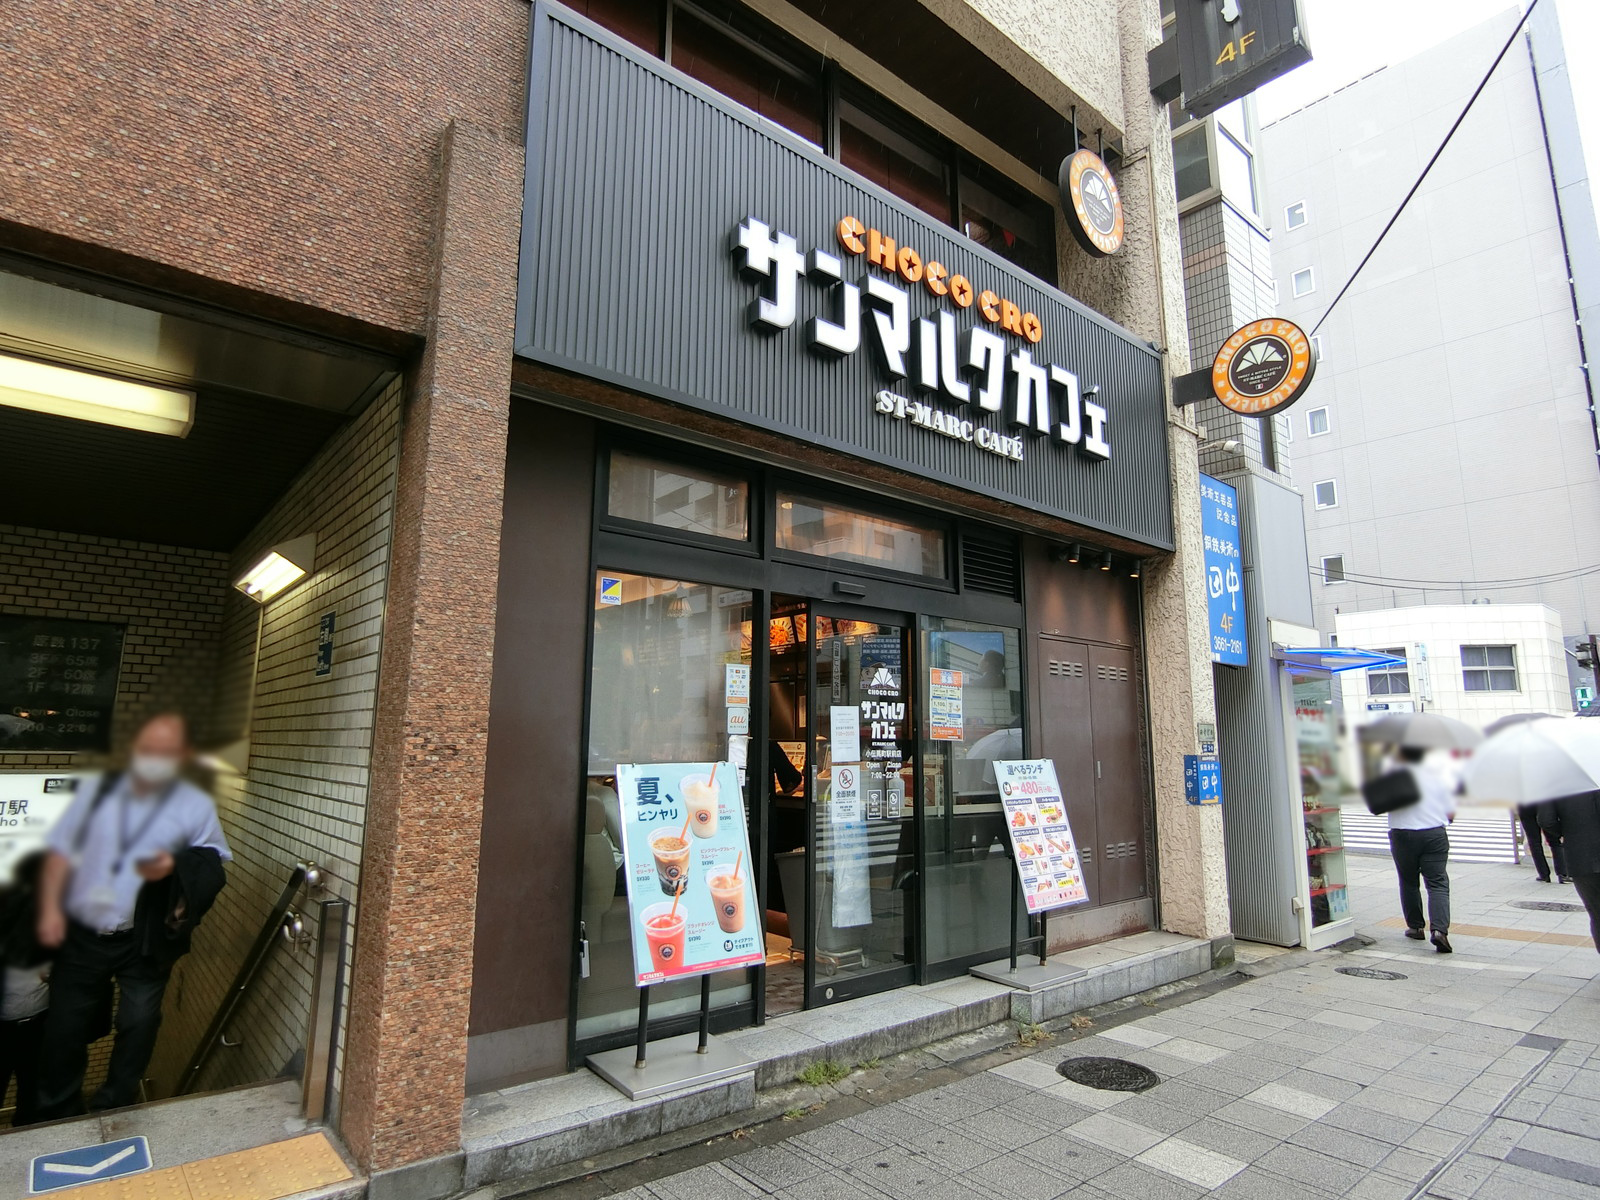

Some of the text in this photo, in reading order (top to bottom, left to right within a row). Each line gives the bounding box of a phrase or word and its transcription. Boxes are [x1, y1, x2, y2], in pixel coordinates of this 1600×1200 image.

[1215, 30, 1256, 66] 4F
[837, 215, 1042, 344] CHOCO CRO
[732, 214, 1111, 461] サンマルクカフェ
[1214, 319, 1307, 374] CHOCO CRO
[875, 389, 1025, 462] ST-MARC CAFÉ
[1215, 506, 1238, 527] 記念品
[1219, 611, 1234, 634] 4F
[70, 636, 101, 651] 137
[30, 652, 49, 664] 3F
[27, 666, 48, 679] 2F
[27, 681, 46, 693] 1F
[730, 715, 746, 724] au
[860, 700, 906, 721] サンマルク
[870, 720, 897, 740] カフェ
[866, 761, 902, 770] Open Close
[637, 808, 678, 822] ヒンヤリ
